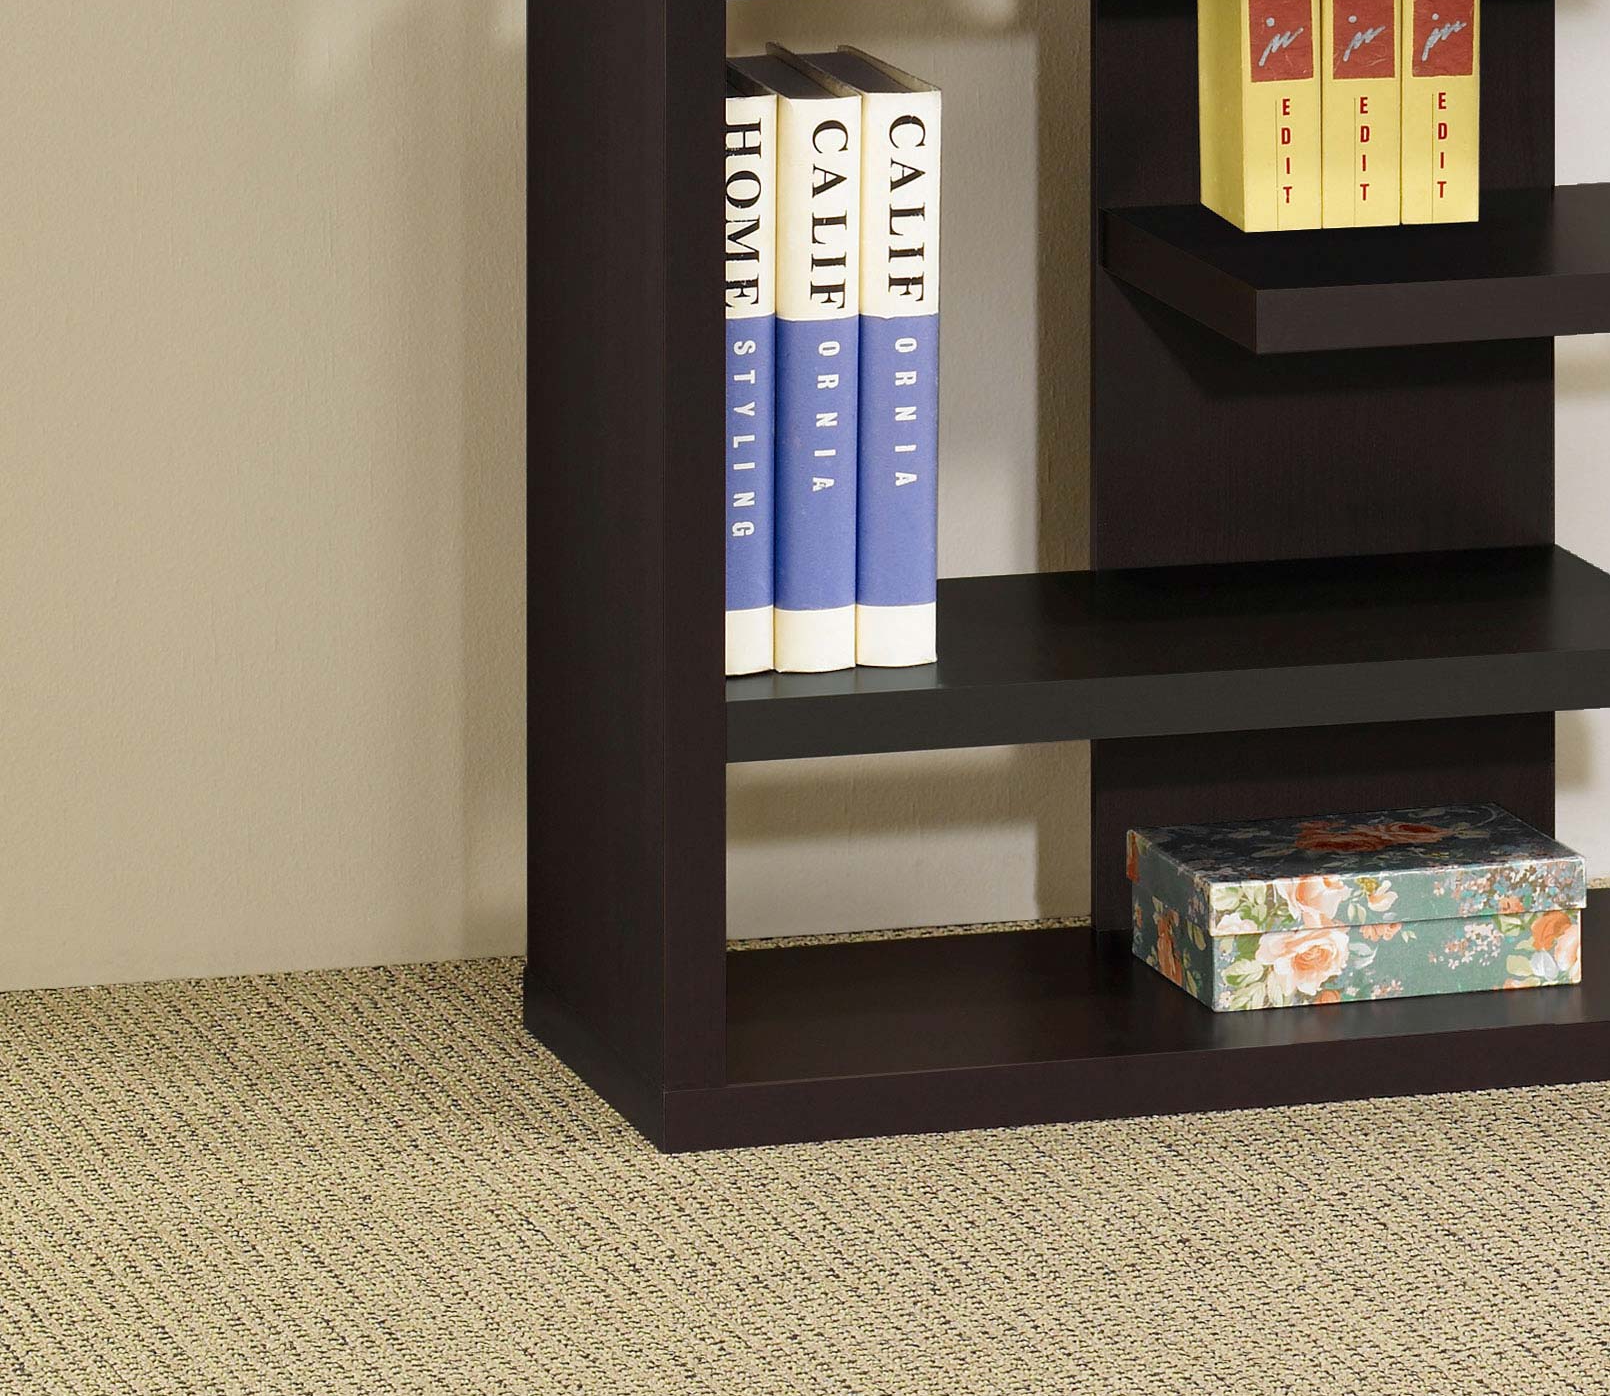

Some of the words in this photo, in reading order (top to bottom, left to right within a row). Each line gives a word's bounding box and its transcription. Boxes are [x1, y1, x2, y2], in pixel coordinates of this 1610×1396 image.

[725, 118, 762, 308] HOME
[810, 120, 849, 309] CALIF
[888, 114, 926, 302] CALIF
[1281, 98, 1292, 204] EDIT
[1360, 97, 1370, 201] EDIT
[1437, 92, 1447, 199] EDIT
[731, 340, 756, 537] STYLING
[812, 340, 841, 492] ORNIA
[894, 337, 918, 487] ORNIA
